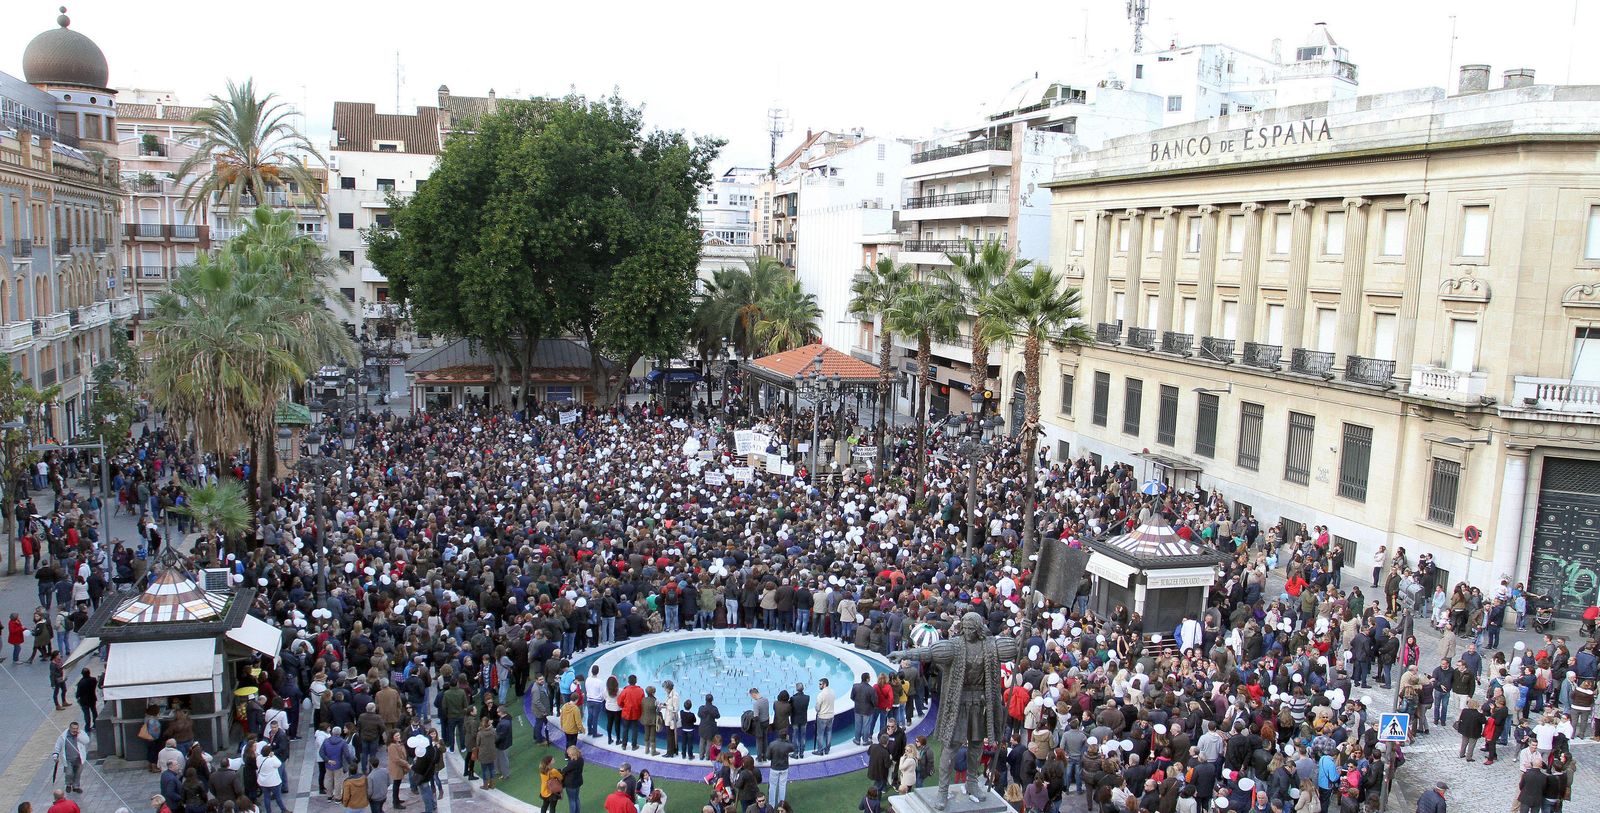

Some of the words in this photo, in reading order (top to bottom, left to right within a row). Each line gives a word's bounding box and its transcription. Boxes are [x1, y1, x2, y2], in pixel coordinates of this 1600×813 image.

[1151, 136, 1211, 162] BANCO
[1220, 139, 1235, 154] DE
[1243, 116, 1333, 151] ESPAÑA
